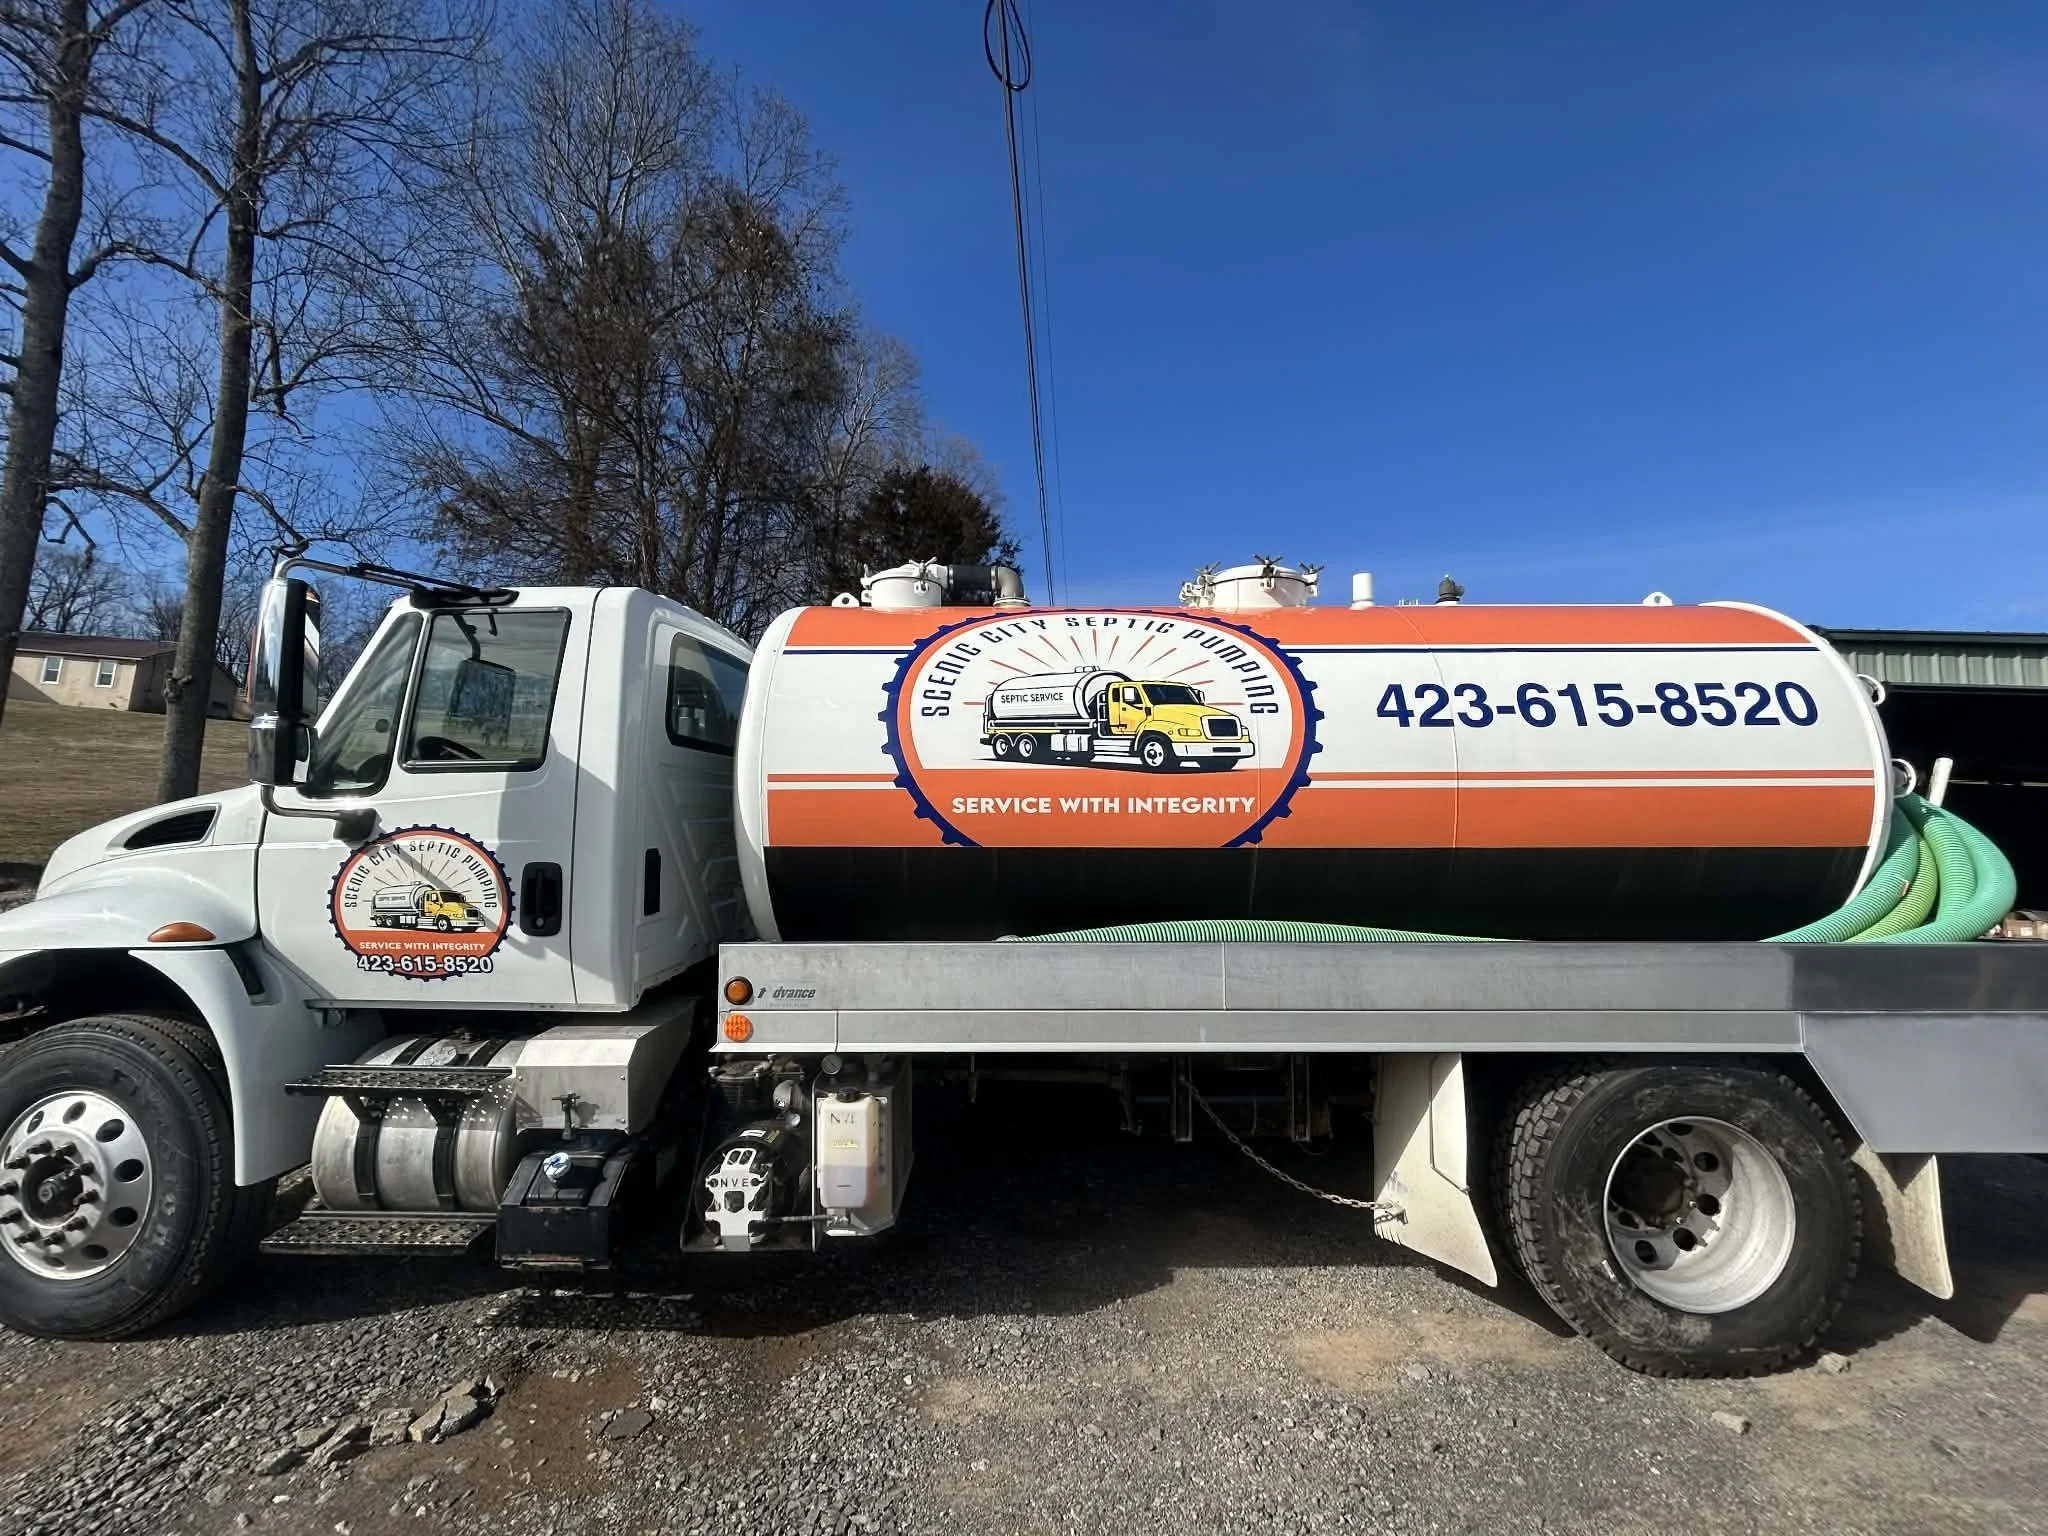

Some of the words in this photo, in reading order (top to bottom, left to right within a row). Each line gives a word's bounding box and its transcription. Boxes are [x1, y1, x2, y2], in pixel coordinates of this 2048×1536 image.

[921, 640, 981, 717] SCENIC
[984, 619, 1048, 644] CITY
[1065, 616, 1174, 634] SEPTIC
[1183, 628, 1279, 716] PUMPING
[1000, 693, 1028, 704] SEPTIC
[1030, 692, 1064, 703] SERVICE
[1376, 681, 1818, 728] 423-615-8520
[952, 797, 1051, 814] SERVICE
[1059, 797, 1120, 814] WITH
[1127, 797, 1256, 814] INTEGRITY
[344, 865, 370, 908] SCENIC
[369, 844, 400, 866] CITY
[409, 840, 461, 859] SEPTIC
[462, 855, 498, 908] PUMPING
[359, 942, 401, 951] SERVICE
[404, 942, 430, 951] WITH
[432, 942, 486, 952] INTEGRITY
[357, 955, 493, 973] 423-615-8520
